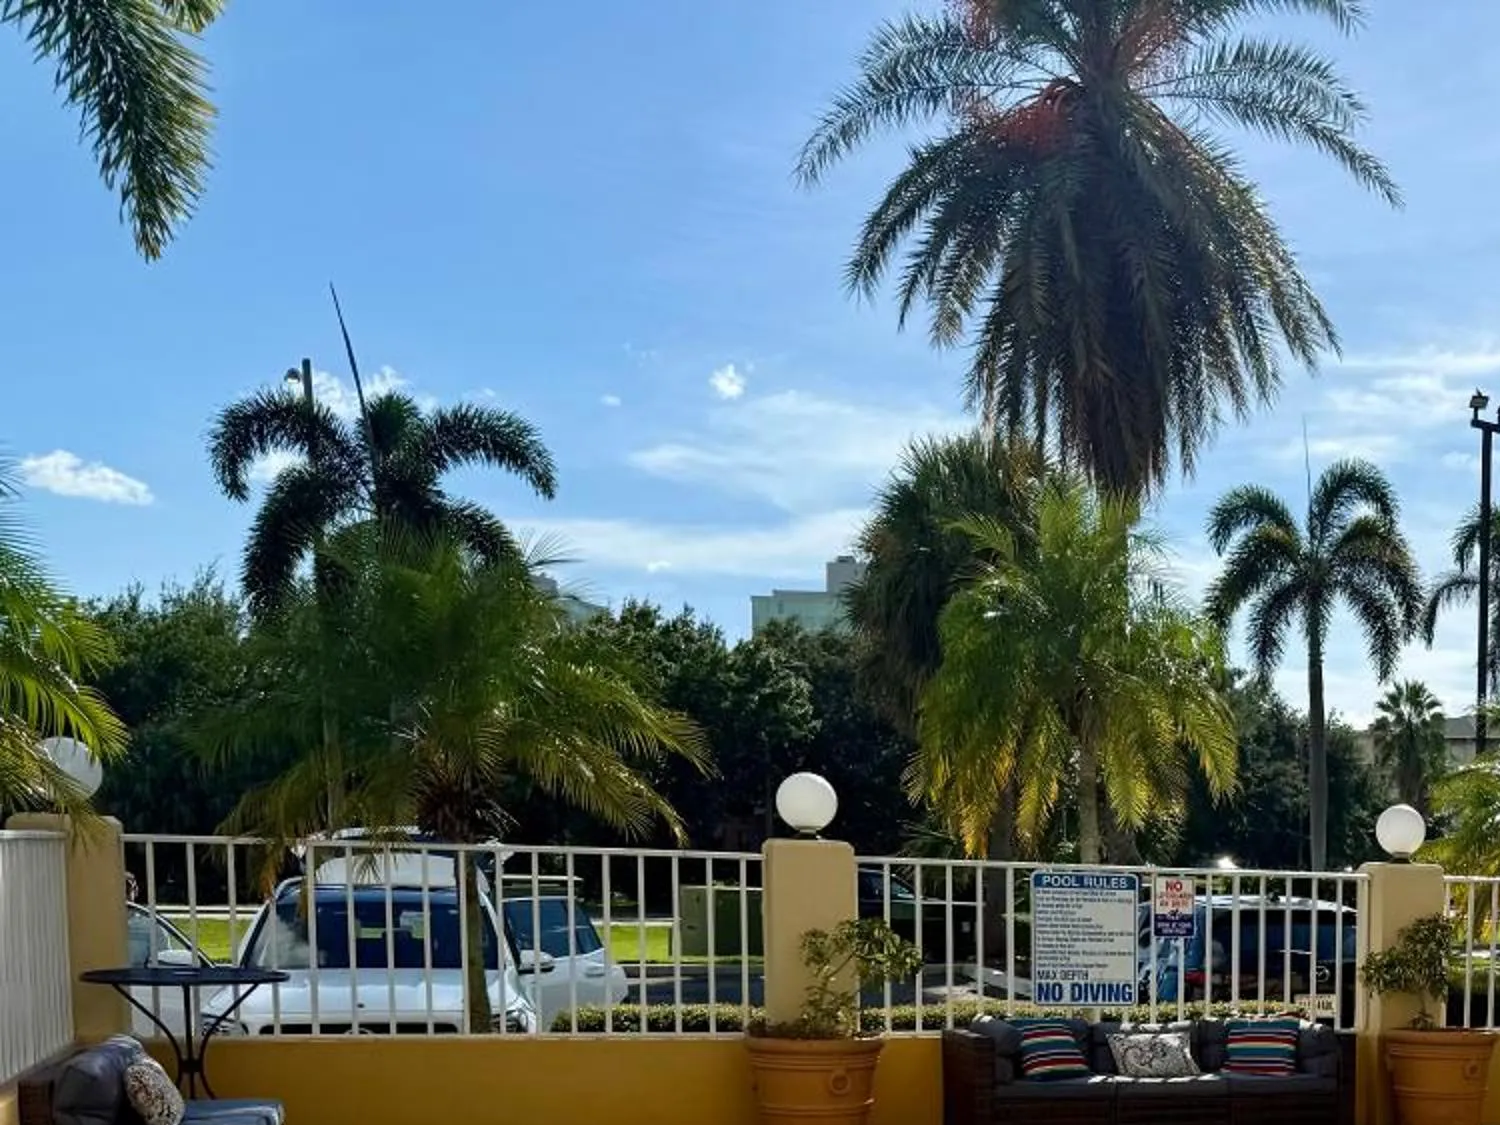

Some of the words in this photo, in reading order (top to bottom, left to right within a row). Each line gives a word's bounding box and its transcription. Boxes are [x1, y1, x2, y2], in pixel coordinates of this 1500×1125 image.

[1042, 875, 1078, 887] POOL
[1083, 876, 1128, 889] RULES
[1165, 880, 1183, 892] NO
[1037, 969, 1057, 981] MAX
[1059, 969, 1089, 981] DEPTH
[1037, 982, 1063, 1003] NO
[1069, 982, 1133, 1003] DIVING
